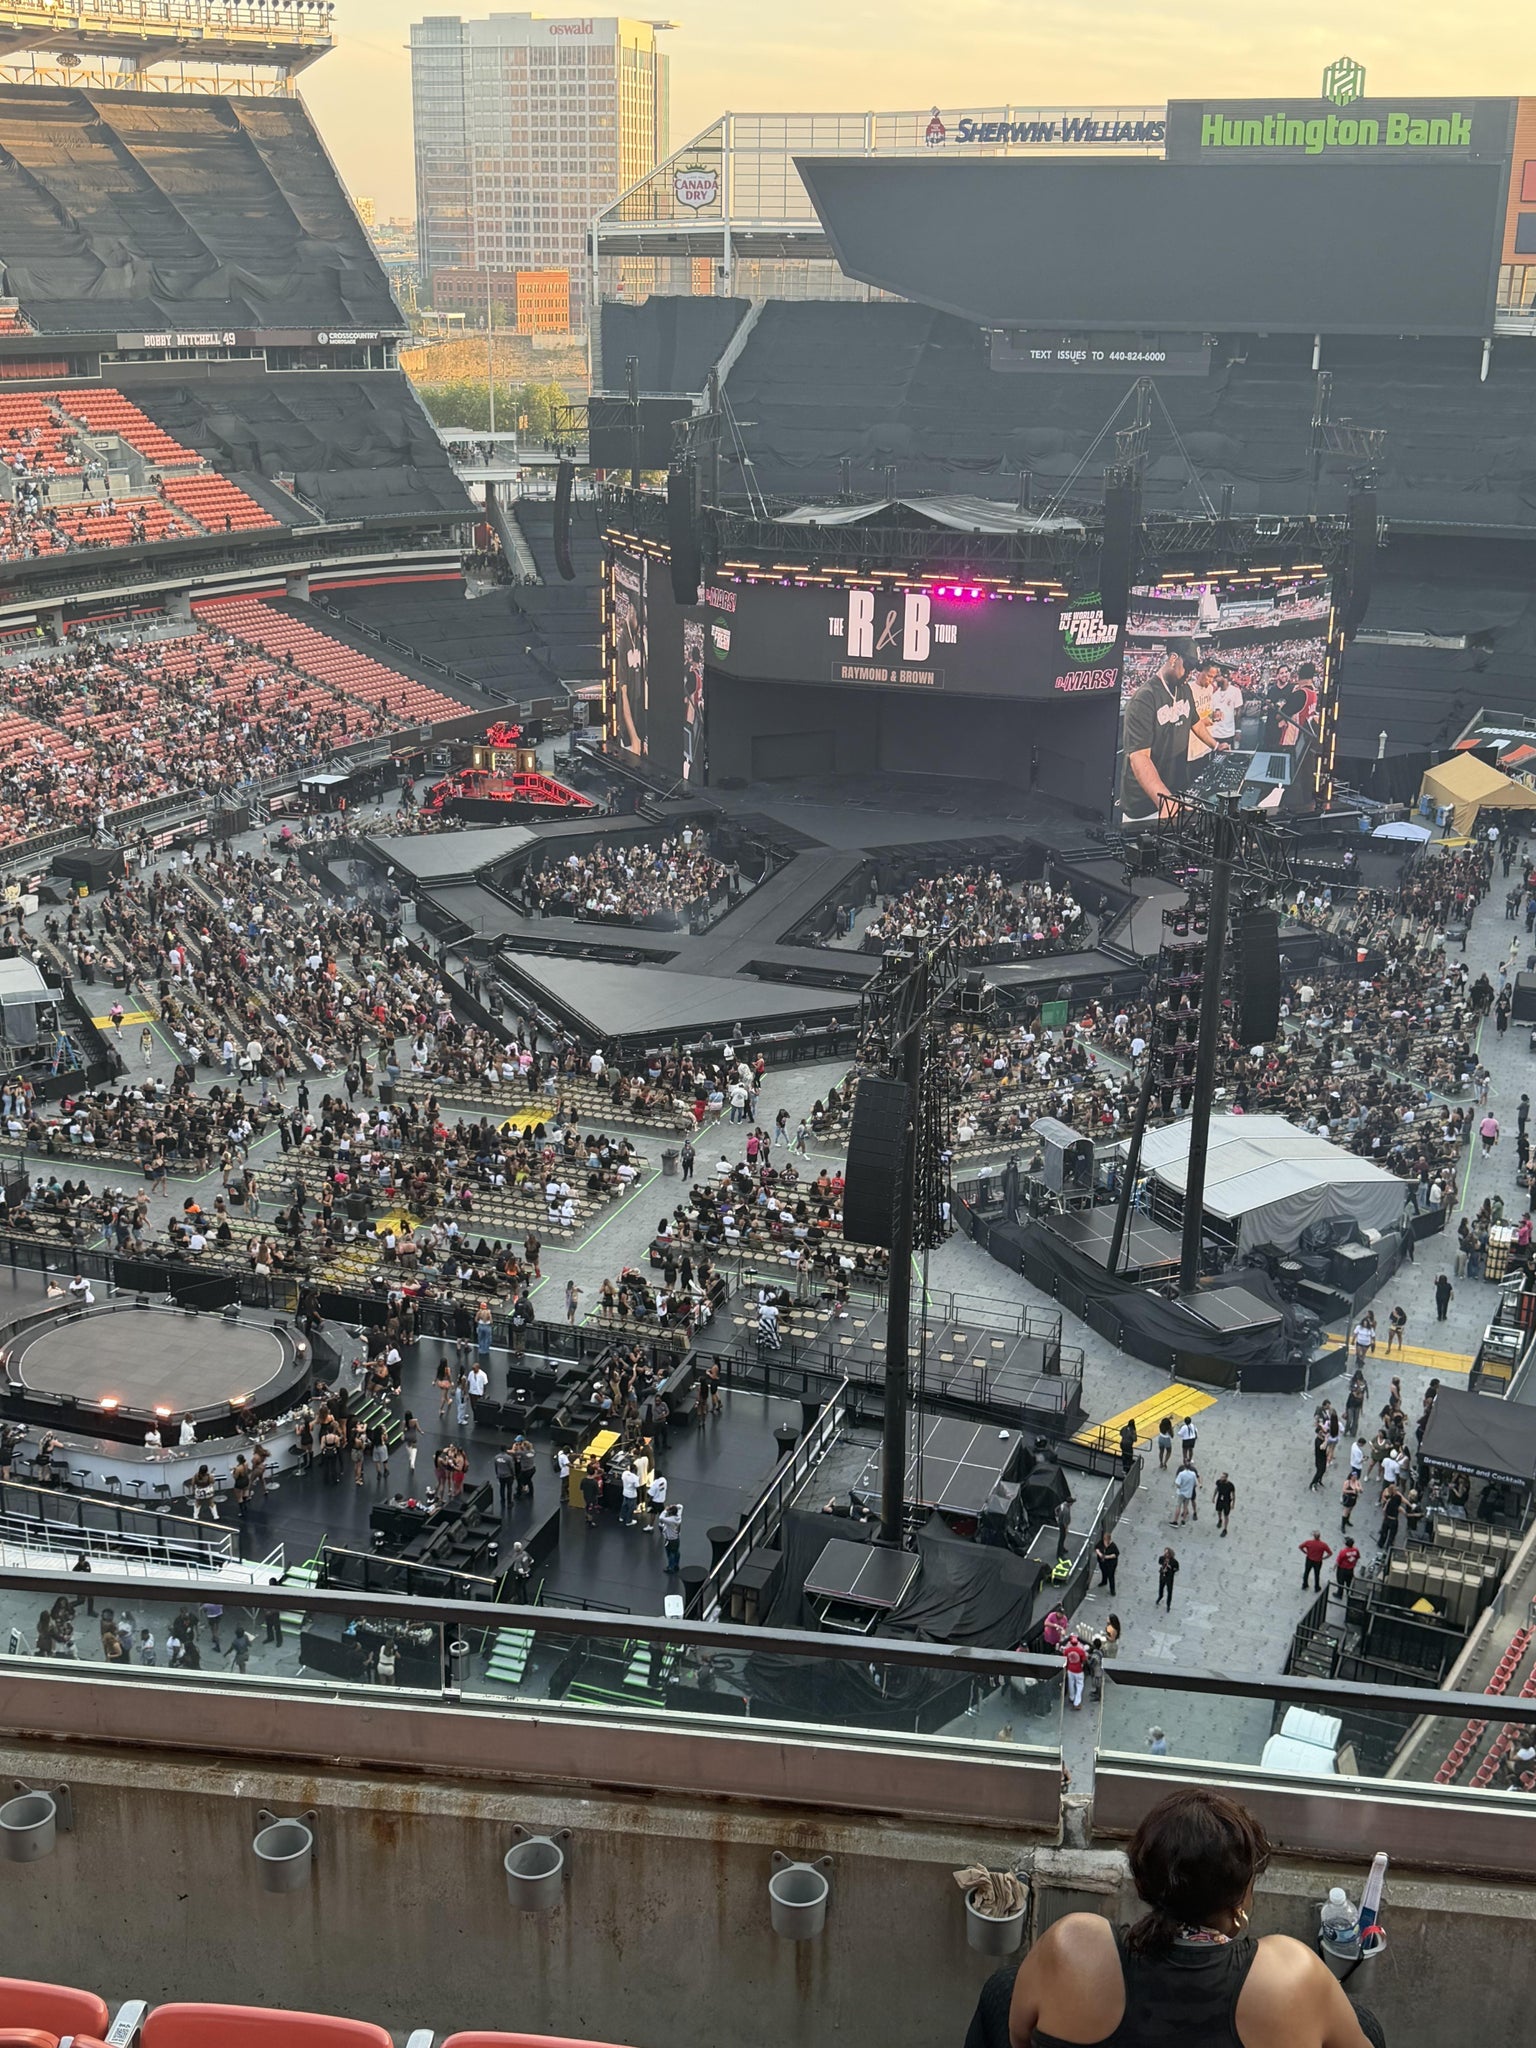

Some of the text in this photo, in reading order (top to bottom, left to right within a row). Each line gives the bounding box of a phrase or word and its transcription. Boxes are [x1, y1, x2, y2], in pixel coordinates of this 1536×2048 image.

[549, 18, 593, 35] oswald
[1201, 112, 1472, 155] Huntington Bank
[674, 179, 719, 190] CANADA
[685, 190, 708, 200] DRY
[144, 331, 236, 347] BOBBY MITCHELL 49
[1030, 350, 1166, 362] TEXT ISSUES TO 440-824-6000
[1060, 612, 1073, 620] THE
[1073, 611, 1096, 620] WORLD
[829, 617, 844, 636] THE
[934, 624, 958, 644] TOUR
[1058, 620, 1070, 631] DJ
[841, 665, 935, 685] RAYMOND & BROWN
[1456, 1464, 1475, 1474] Beer
[1475, 1470, 1491, 1478] and
[1491, 1473, 1526, 1487] Cocktails
